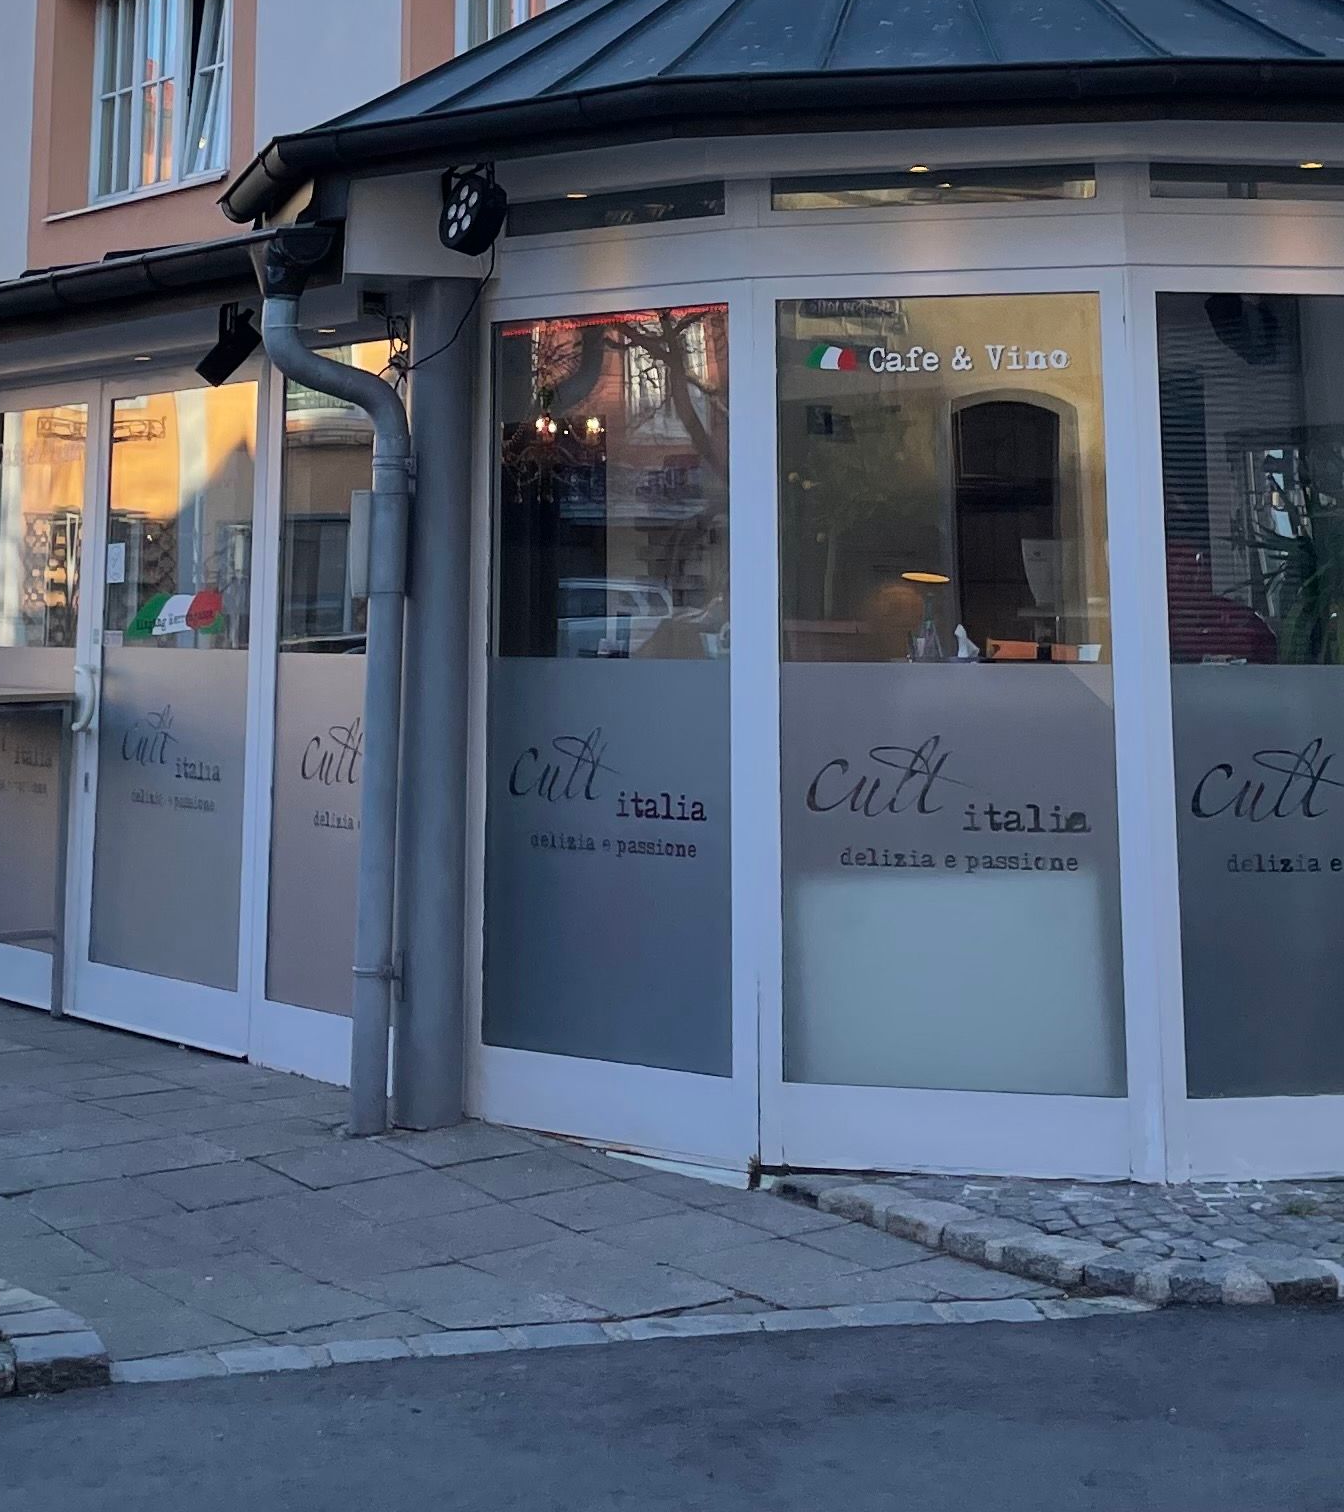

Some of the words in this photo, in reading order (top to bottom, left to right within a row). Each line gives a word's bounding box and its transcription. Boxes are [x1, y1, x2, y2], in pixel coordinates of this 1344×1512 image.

[868, 345, 940, 373] Cafe
[951, 345, 974, 372] &
[984, 344, 1071, 371] Vino
[616, 791, 708, 822] italia
[962, 803, 1093, 834] italia
[530, 831, 596, 851] delizia
[602, 838, 611, 850] e
[616, 838, 697, 859] passione
[840, 847, 937, 869] delizia
[945, 854, 958, 869] e
[965, 852, 1080, 875] passione
[1227, 853, 1322, 874] delizia
[1330, 857, 1343, 873] e
